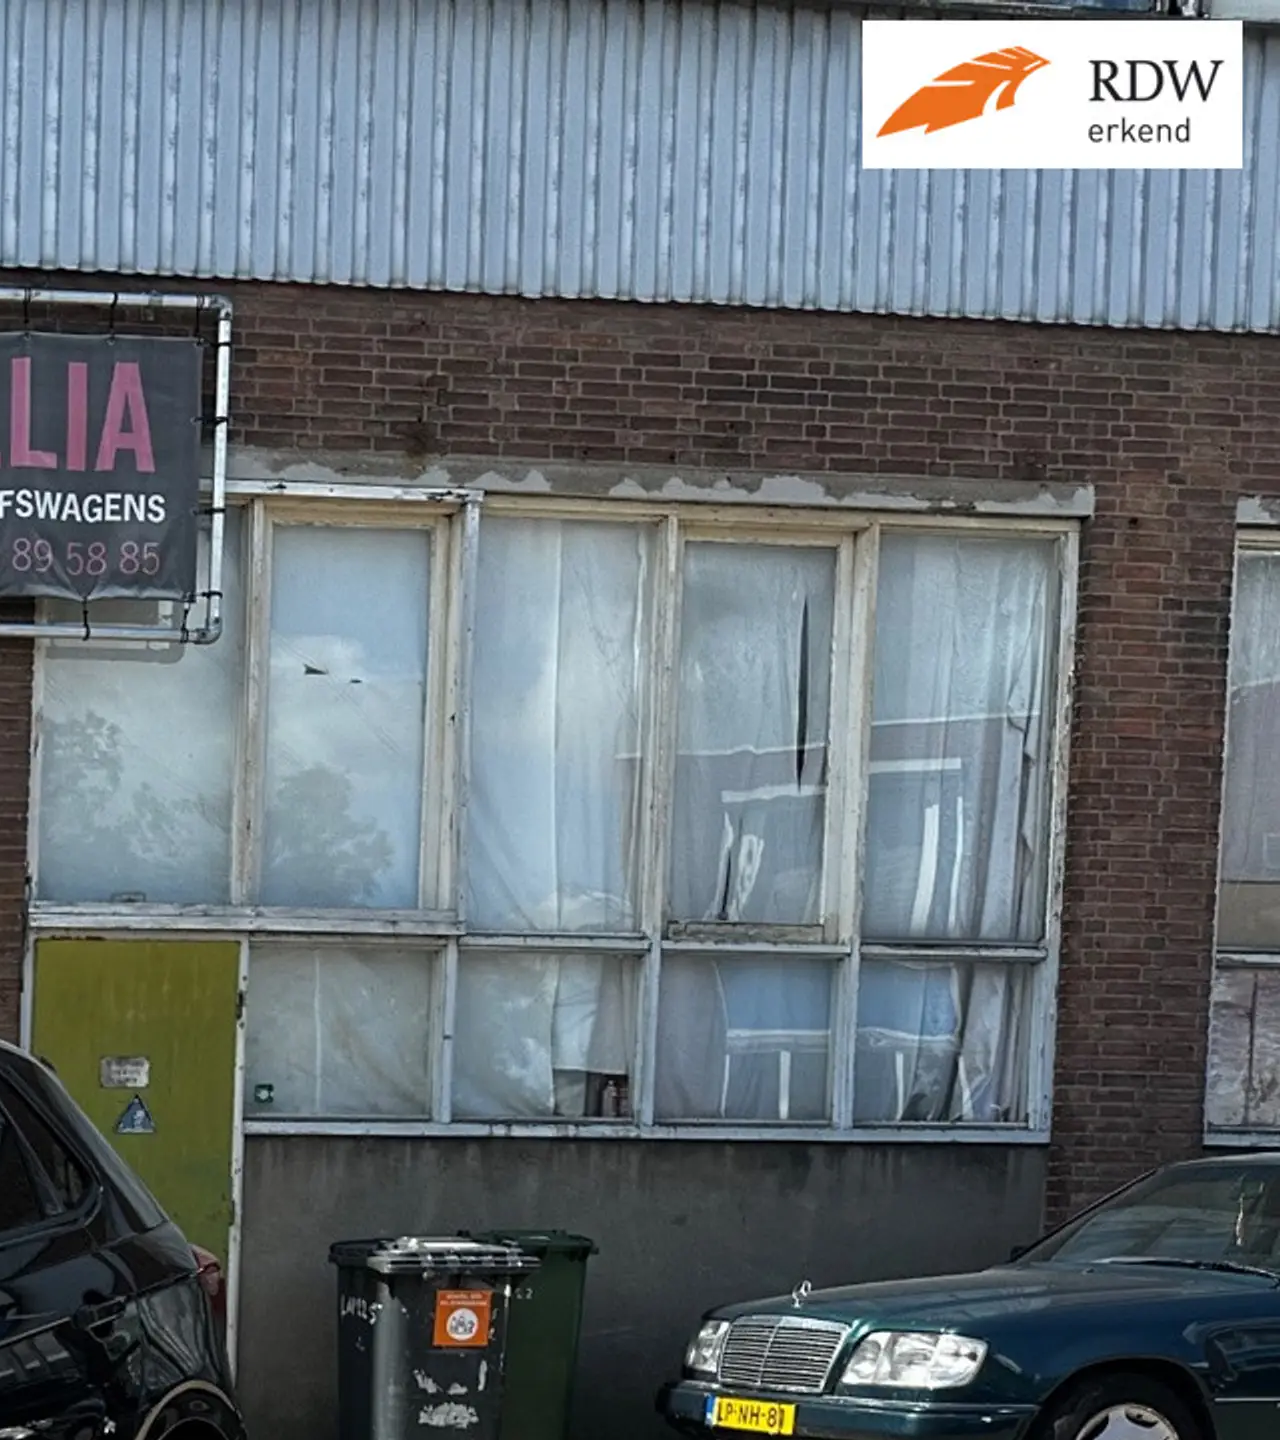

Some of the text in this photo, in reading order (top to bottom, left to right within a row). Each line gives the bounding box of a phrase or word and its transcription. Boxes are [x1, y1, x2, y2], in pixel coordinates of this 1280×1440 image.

[12, 537, 54, 573] 89
[66, 540, 108, 576] 58
[119, 540, 161, 577] 85
